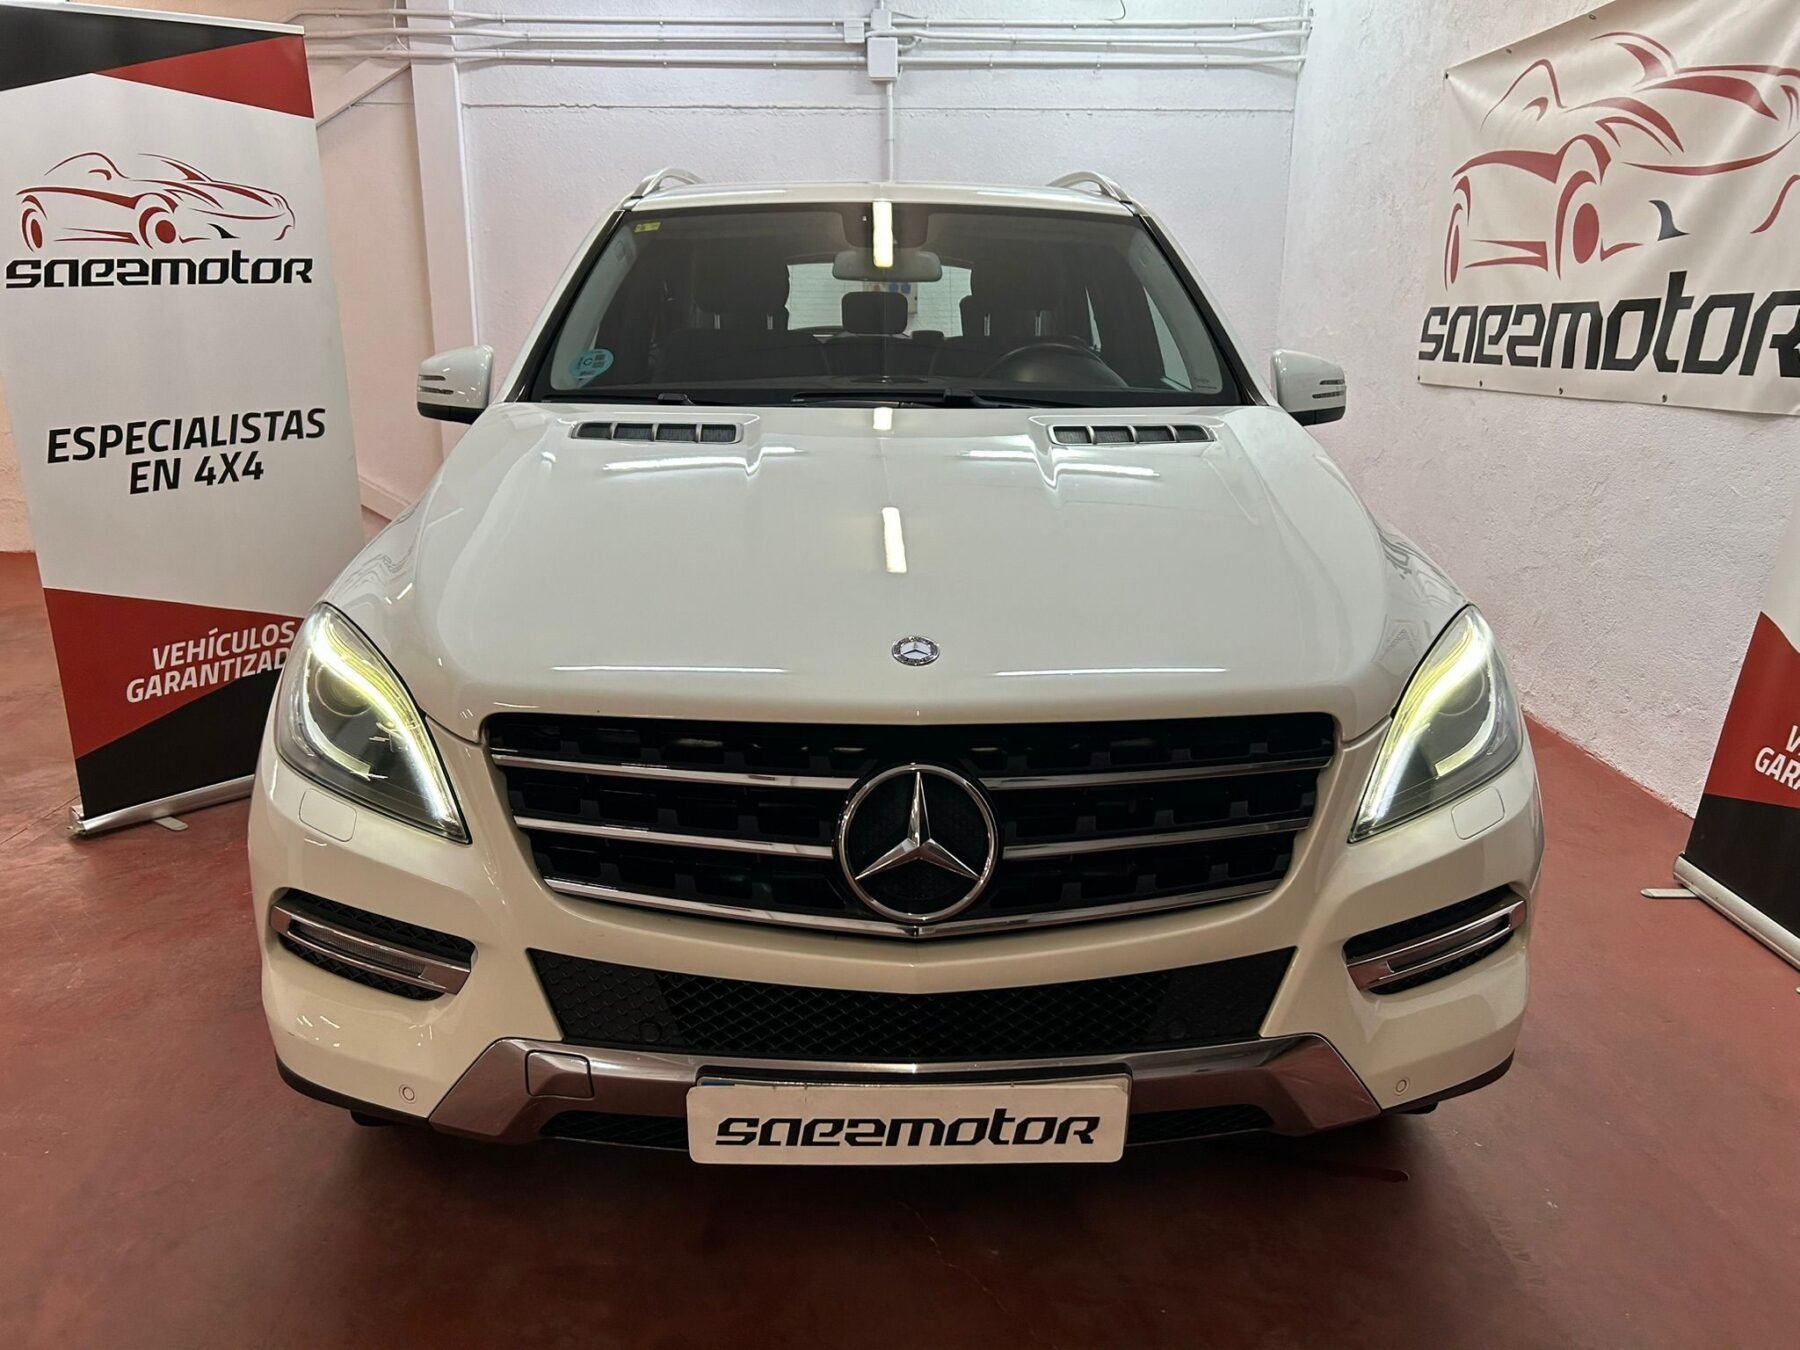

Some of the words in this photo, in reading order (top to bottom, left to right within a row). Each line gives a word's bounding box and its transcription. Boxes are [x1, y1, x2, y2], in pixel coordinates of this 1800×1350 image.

[48, 408, 326, 463] ESPECIALISTAS
[130, 458, 181, 494] EN
[194, 450, 264, 486] 4X4
[152, 621, 296, 670] VEHÍCULOS
[126, 647, 291, 703] GARANTIZAD
